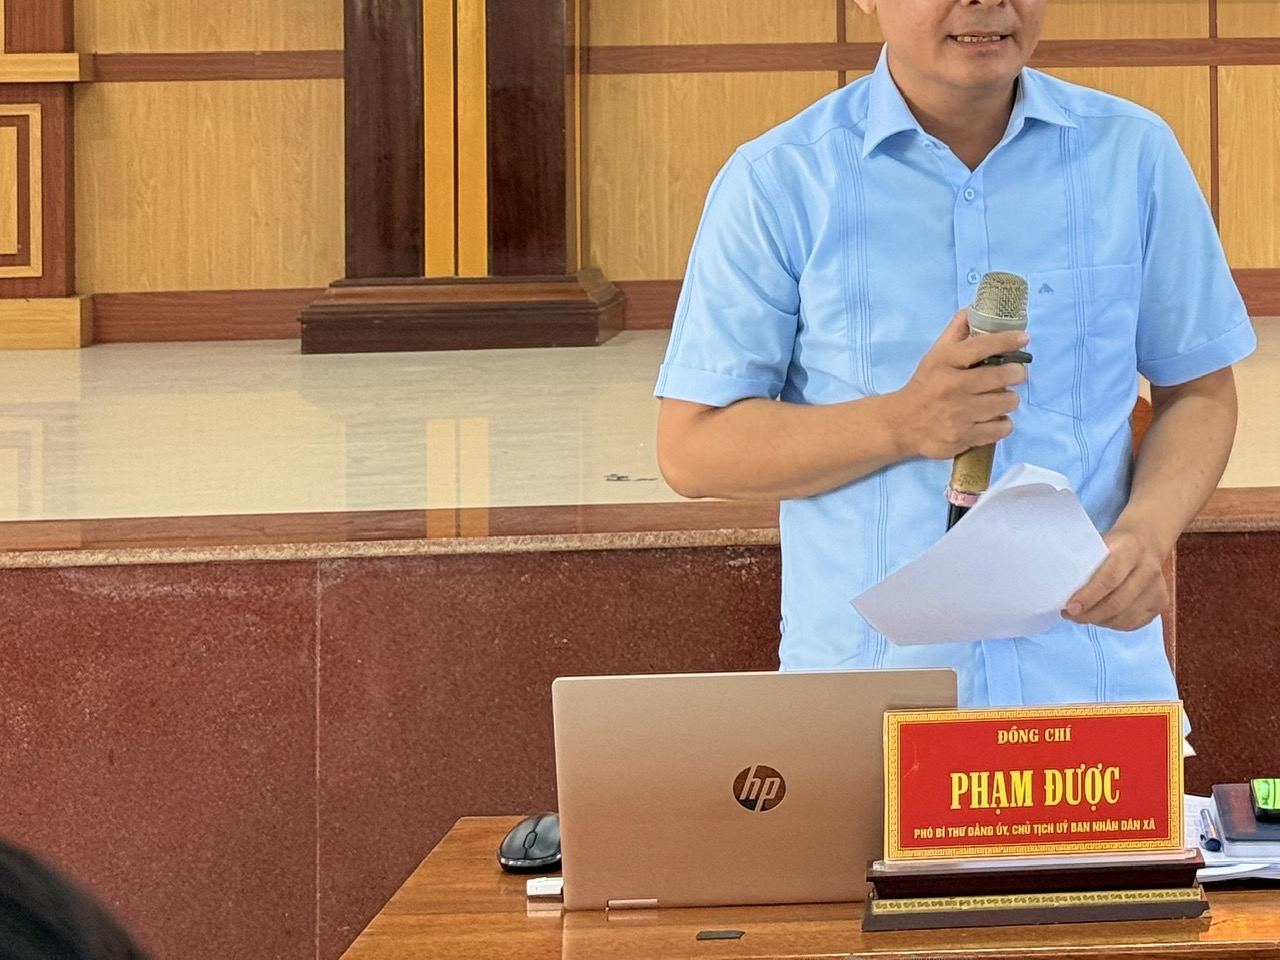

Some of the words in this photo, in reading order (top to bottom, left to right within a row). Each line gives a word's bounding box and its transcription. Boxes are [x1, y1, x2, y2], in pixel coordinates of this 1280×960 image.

[1045, 725, 1070, 741] CHÍ
[739, 765, 780, 812] hp
[951, 770, 1033, 814] PHẠM
[1044, 764, 1119, 810] ĐƯỢC
[914, 826, 933, 839] PHÓ
[935, 826, 946, 838] BÍ
[948, 825, 967, 837] THƯ
[1012, 821, 1031, 835] CHỦ
[1032, 823, 1054, 837] TỊCH
[1071, 821, 1091, 833] BAN
[1092, 819, 1119, 832] NHÂN
[1121, 818, 1140, 831] DÂN
[1143, 818, 1156, 830] XÃ
